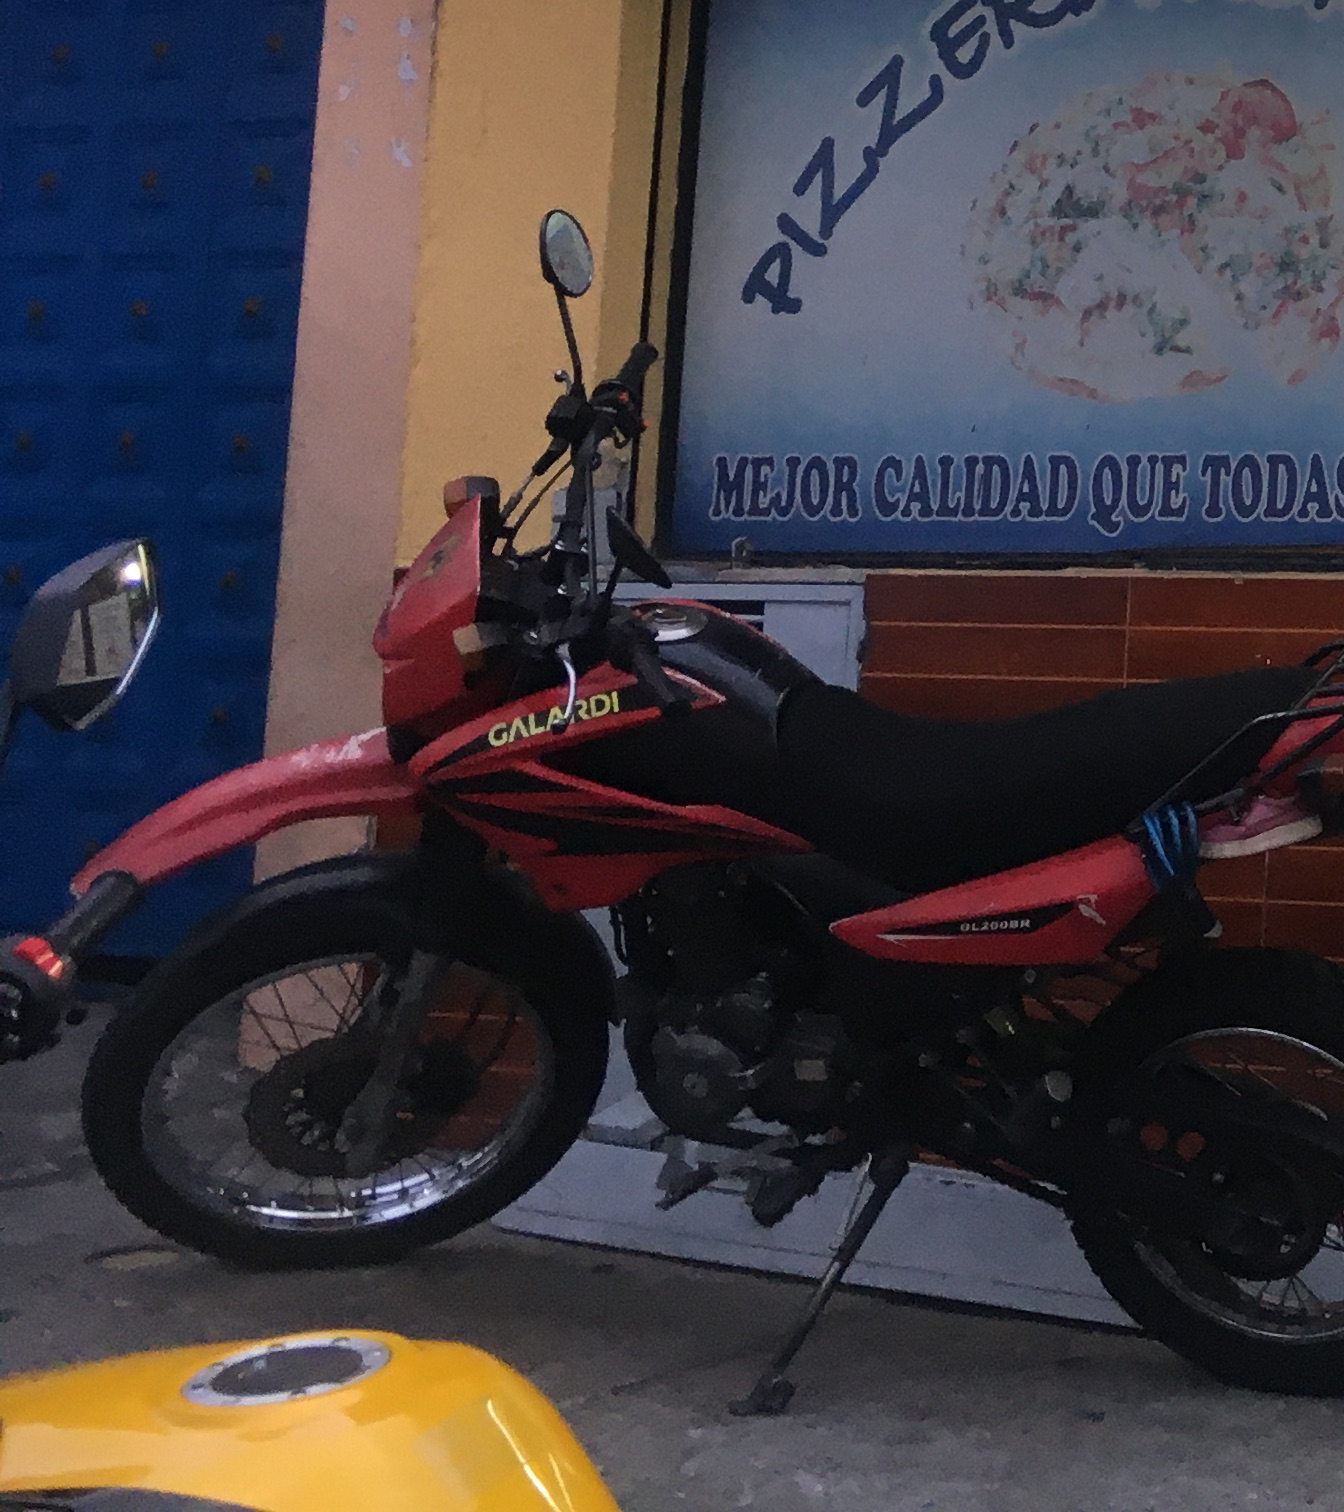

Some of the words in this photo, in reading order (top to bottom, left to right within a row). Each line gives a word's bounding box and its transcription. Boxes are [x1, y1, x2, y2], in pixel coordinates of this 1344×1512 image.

[710, 452, 859, 523] MEJOR
[874, 452, 1079, 523] CALIDAD
[1090, 452, 1188, 534] QUE
[488, 691, 620, 747] GALARDI
